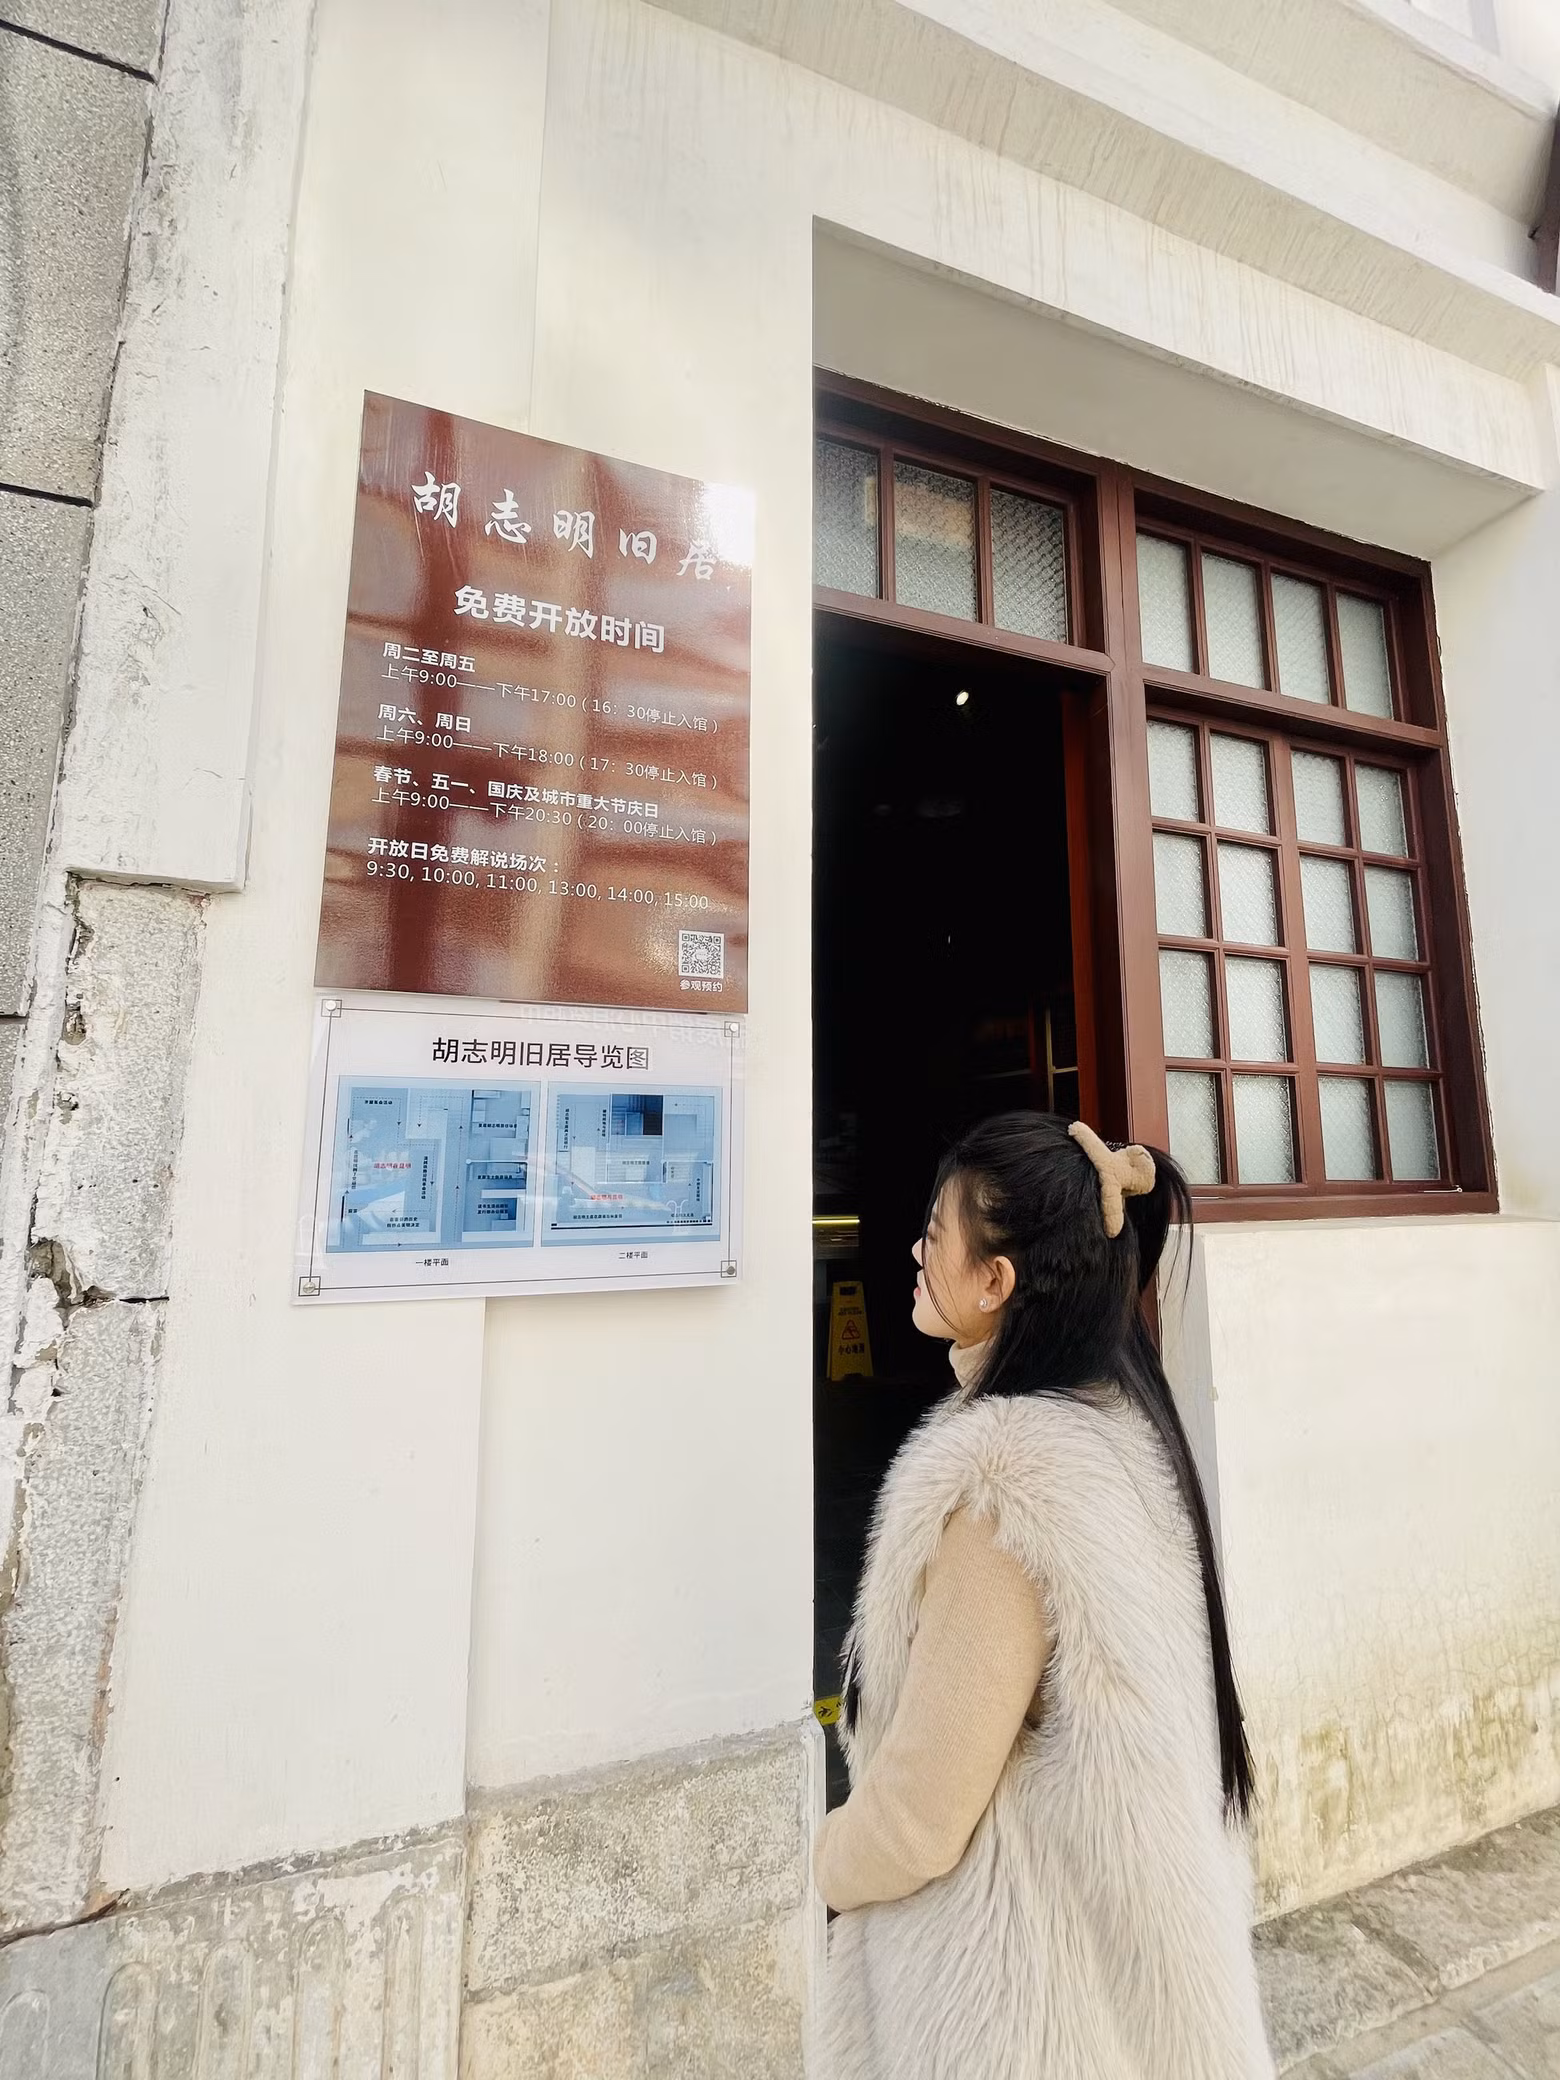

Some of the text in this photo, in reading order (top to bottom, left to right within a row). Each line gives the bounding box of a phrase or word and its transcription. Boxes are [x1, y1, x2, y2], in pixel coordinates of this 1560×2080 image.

[411, 471, 718, 580] 胡志明旧居
[454, 585, 665, 653] 免费开放时间
[382, 642, 476, 673] 周二至周五
[377, 703, 472, 732] 周六、周日
[373, 765, 659, 818] 春节、五一、国庆及城市重大节庆日
[368, 837, 560, 874] 开放日免费解说场次：
[366, 860, 709, 909] 9:30, 10:00, 11:00, 13:00, 14:00, 15:00
[680, 979, 723, 992] 参观预约
[432, 1037, 649, 1071] 胡志明旧居导览图
[415, 1258, 449, 1267] 一楼平面
[618, 1251, 649, 1259] 二楼平面
